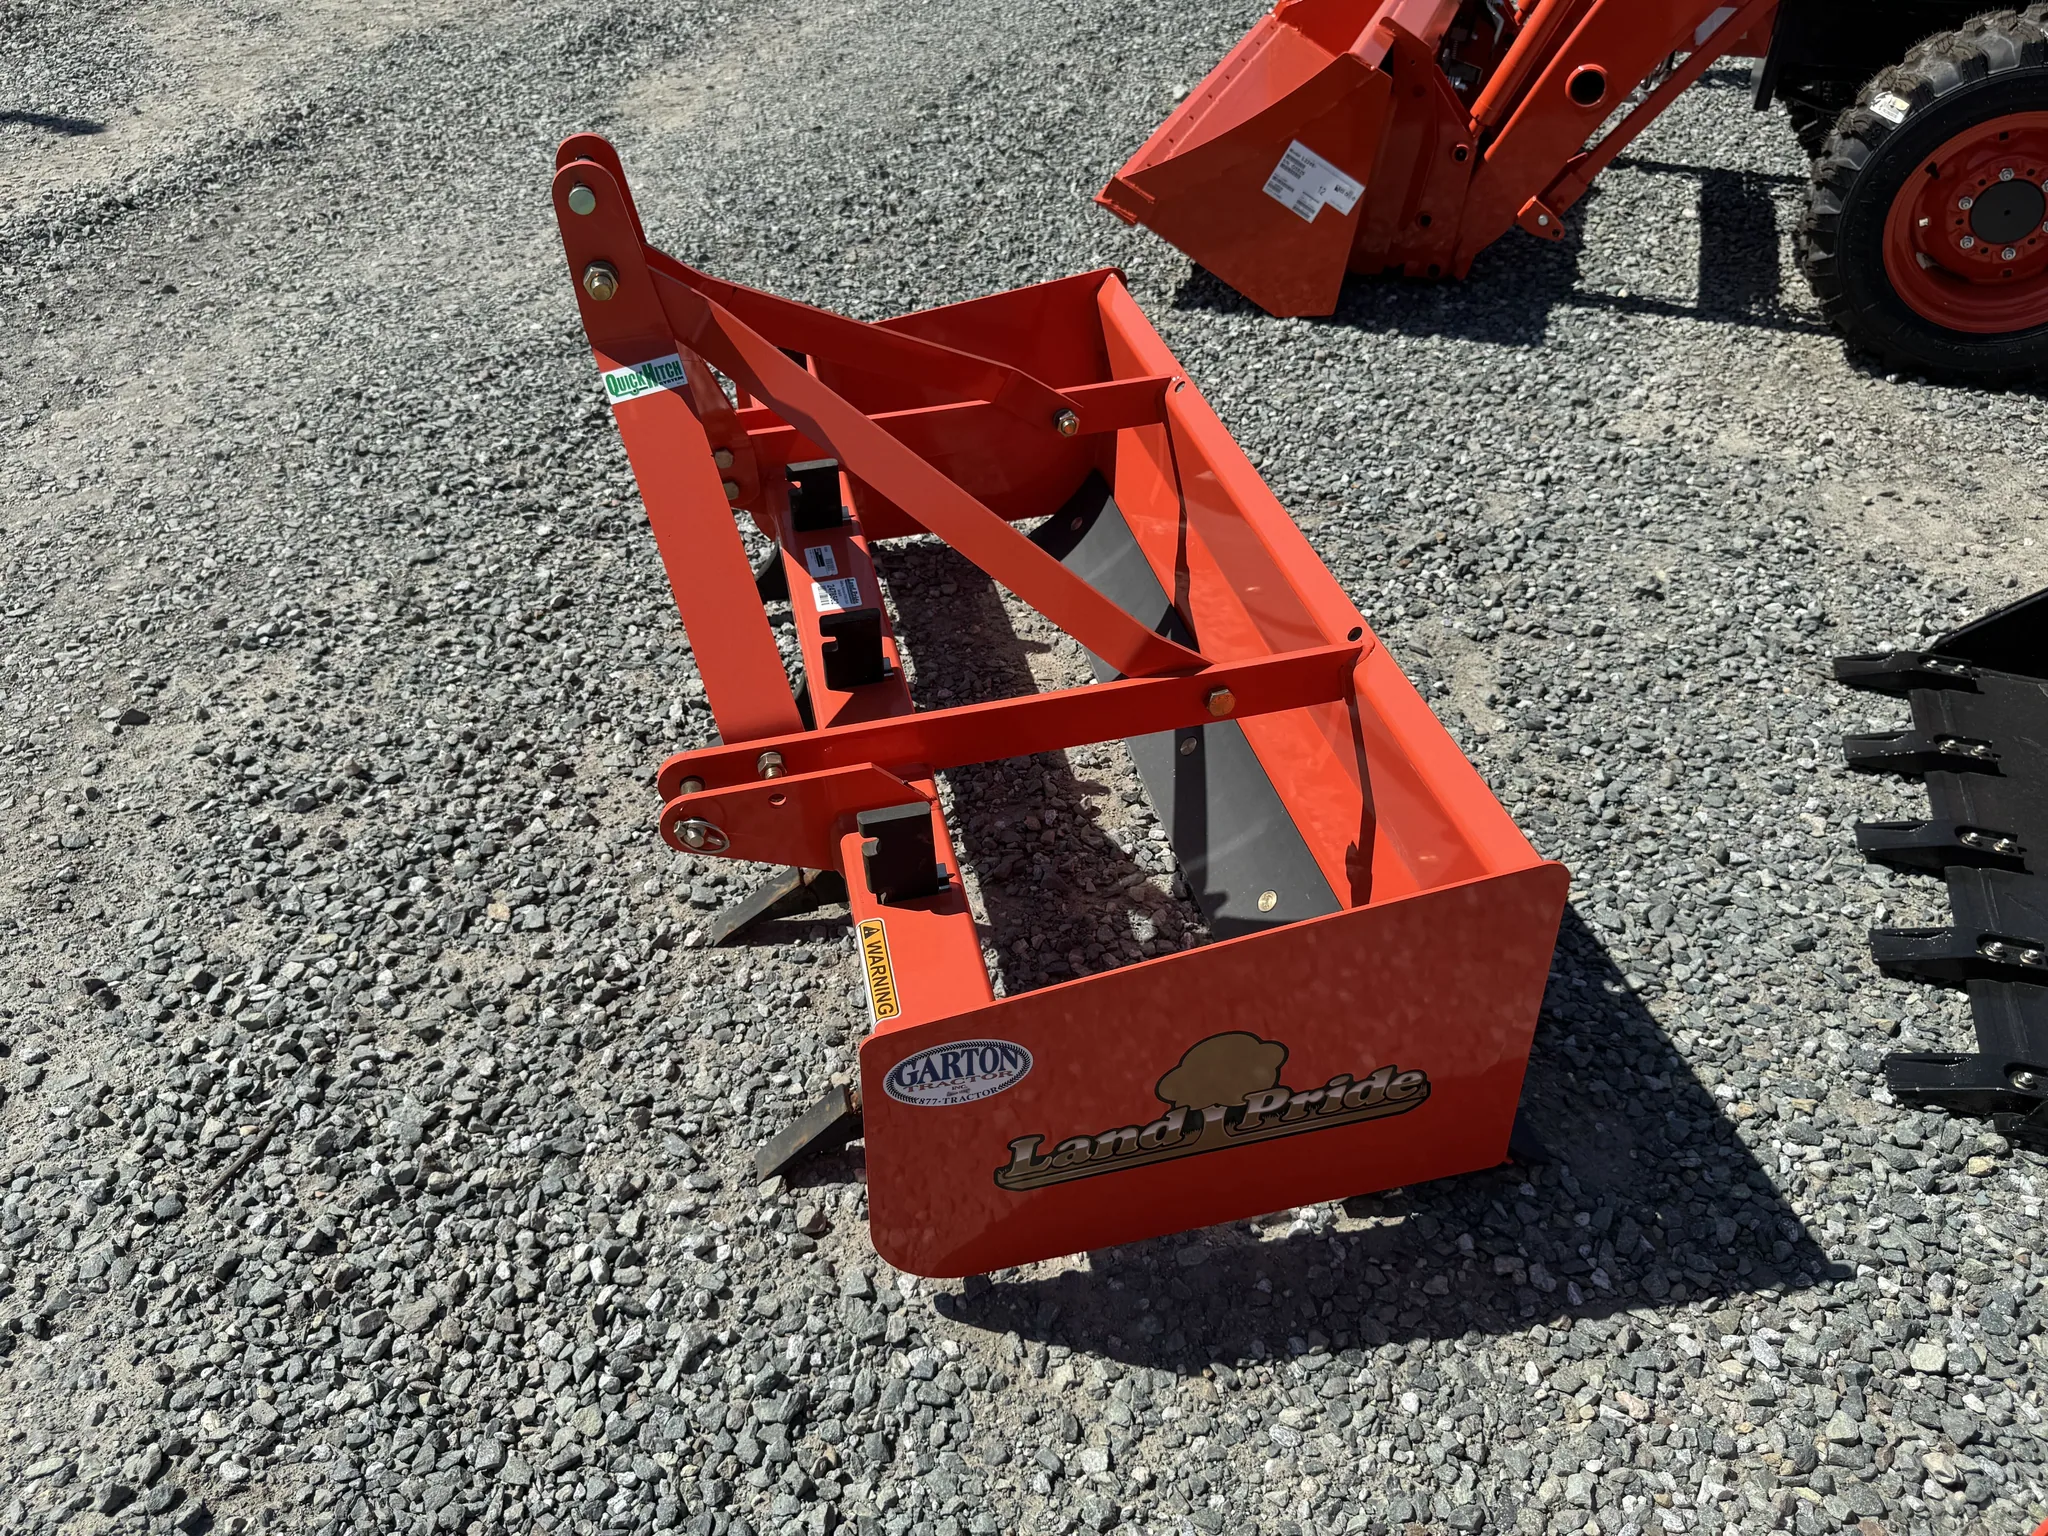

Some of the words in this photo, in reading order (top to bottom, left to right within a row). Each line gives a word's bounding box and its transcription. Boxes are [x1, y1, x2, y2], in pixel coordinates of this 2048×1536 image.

[1318, 185, 1327, 196] 12
[866, 940, 894, 1015] WARNING
[894, 1046, 1020, 1087] GARTON
[902, 1070, 1014, 1093] TRACTOR
[918, 1086, 999, 1105] 877-TRACTOR
[1008, 1106, 1191, 1178] Land
[1233, 1066, 1425, 1130] Pride
